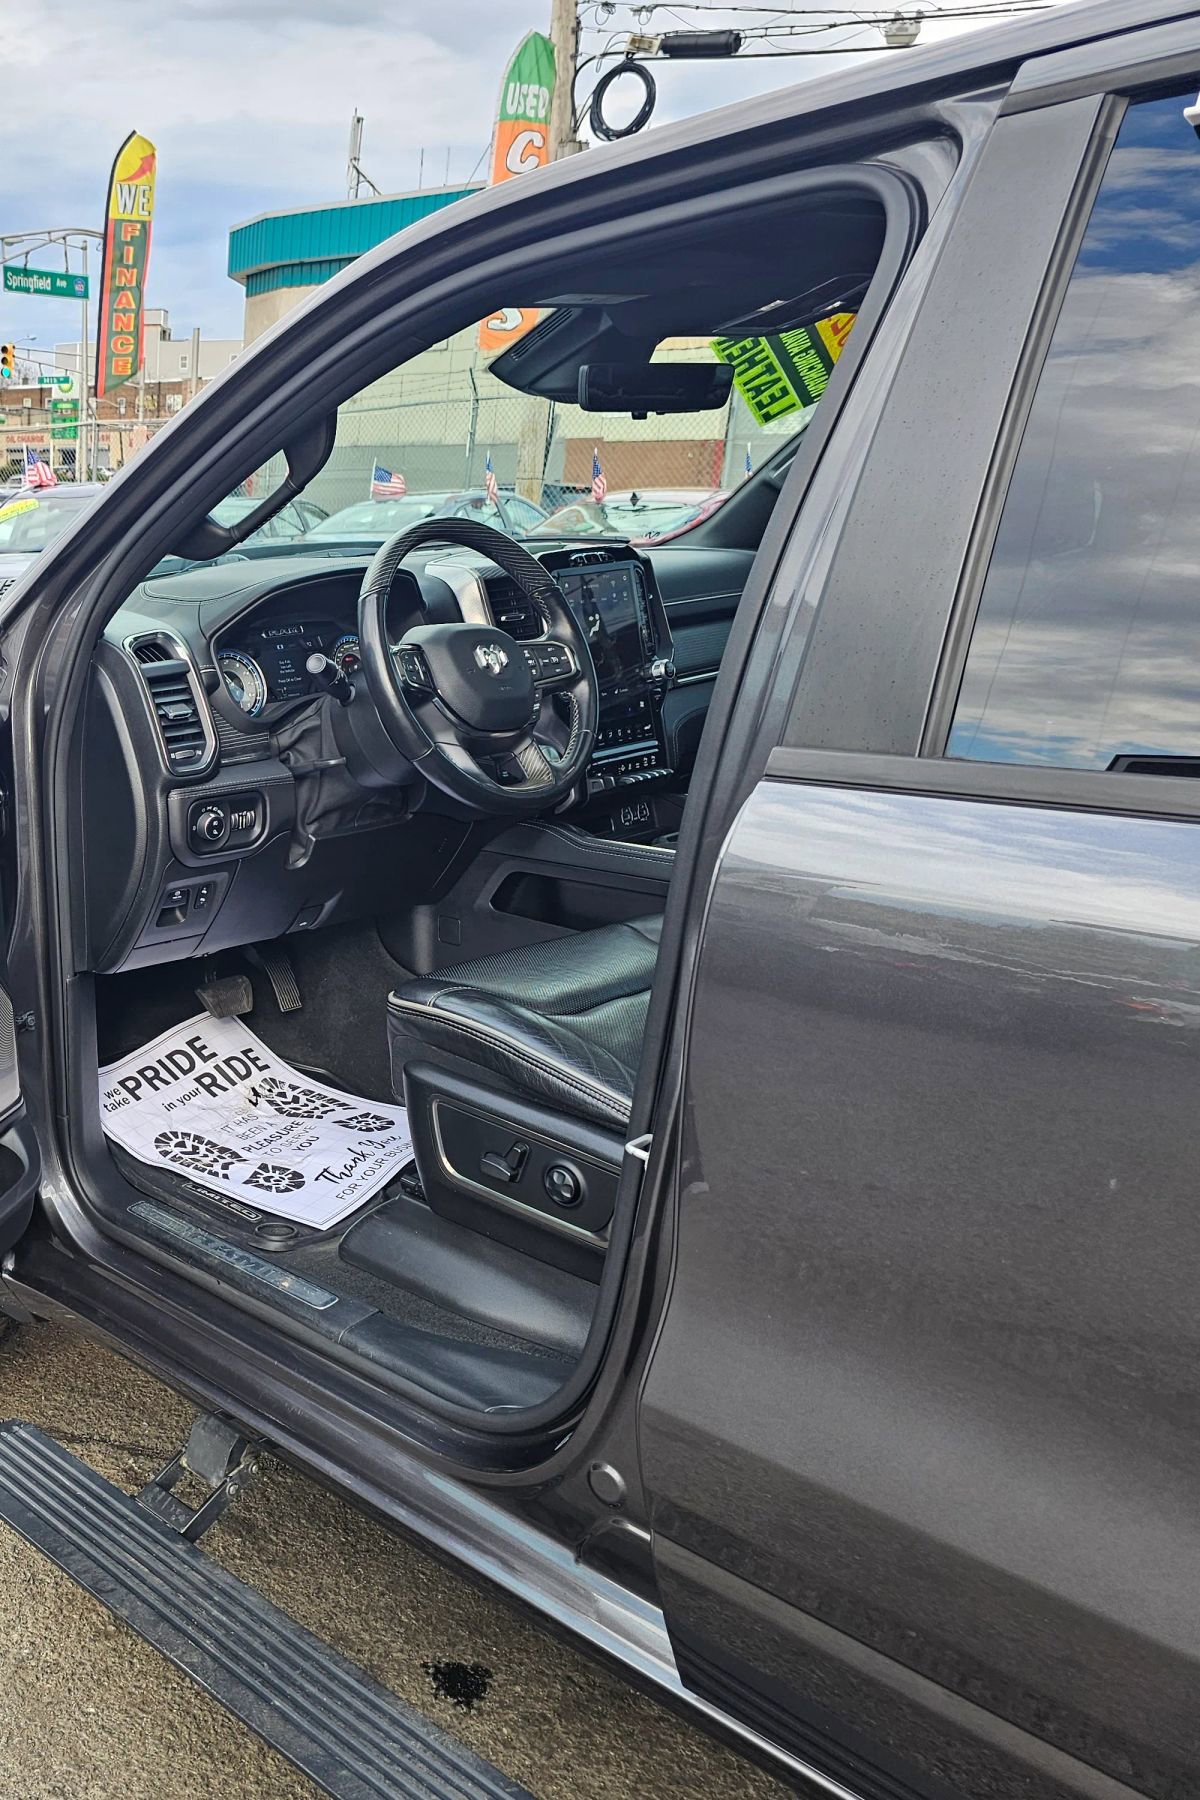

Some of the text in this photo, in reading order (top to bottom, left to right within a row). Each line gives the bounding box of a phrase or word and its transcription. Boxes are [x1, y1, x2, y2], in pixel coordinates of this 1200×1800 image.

[506, 82, 549, 118] USED
[116, 182, 152, 216] WE
[6, 271, 51, 292] Springfield
[56, 278, 67, 288] Ave
[111, 222, 140, 376] FINANCE
[17, 434, 45, 443] CHANGE
[103, 1035, 218, 1113] we take PRIDE
[162, 1047, 271, 1112] in your RIDE
[220, 1113, 259, 1134] IT HAS
[236, 1125, 268, 1141] BEEN
[241, 1120, 305, 1153] PLEASURE
[262, 1125, 317, 1156] TO SERVE
[292, 1136, 320, 1151] YOU
[314, 1147, 376, 1184] Thank
[335, 1183, 362, 1200] FOR
[356, 1158, 389, 1181] YOUR
[186, 1184, 257, 1218] LIMITED
